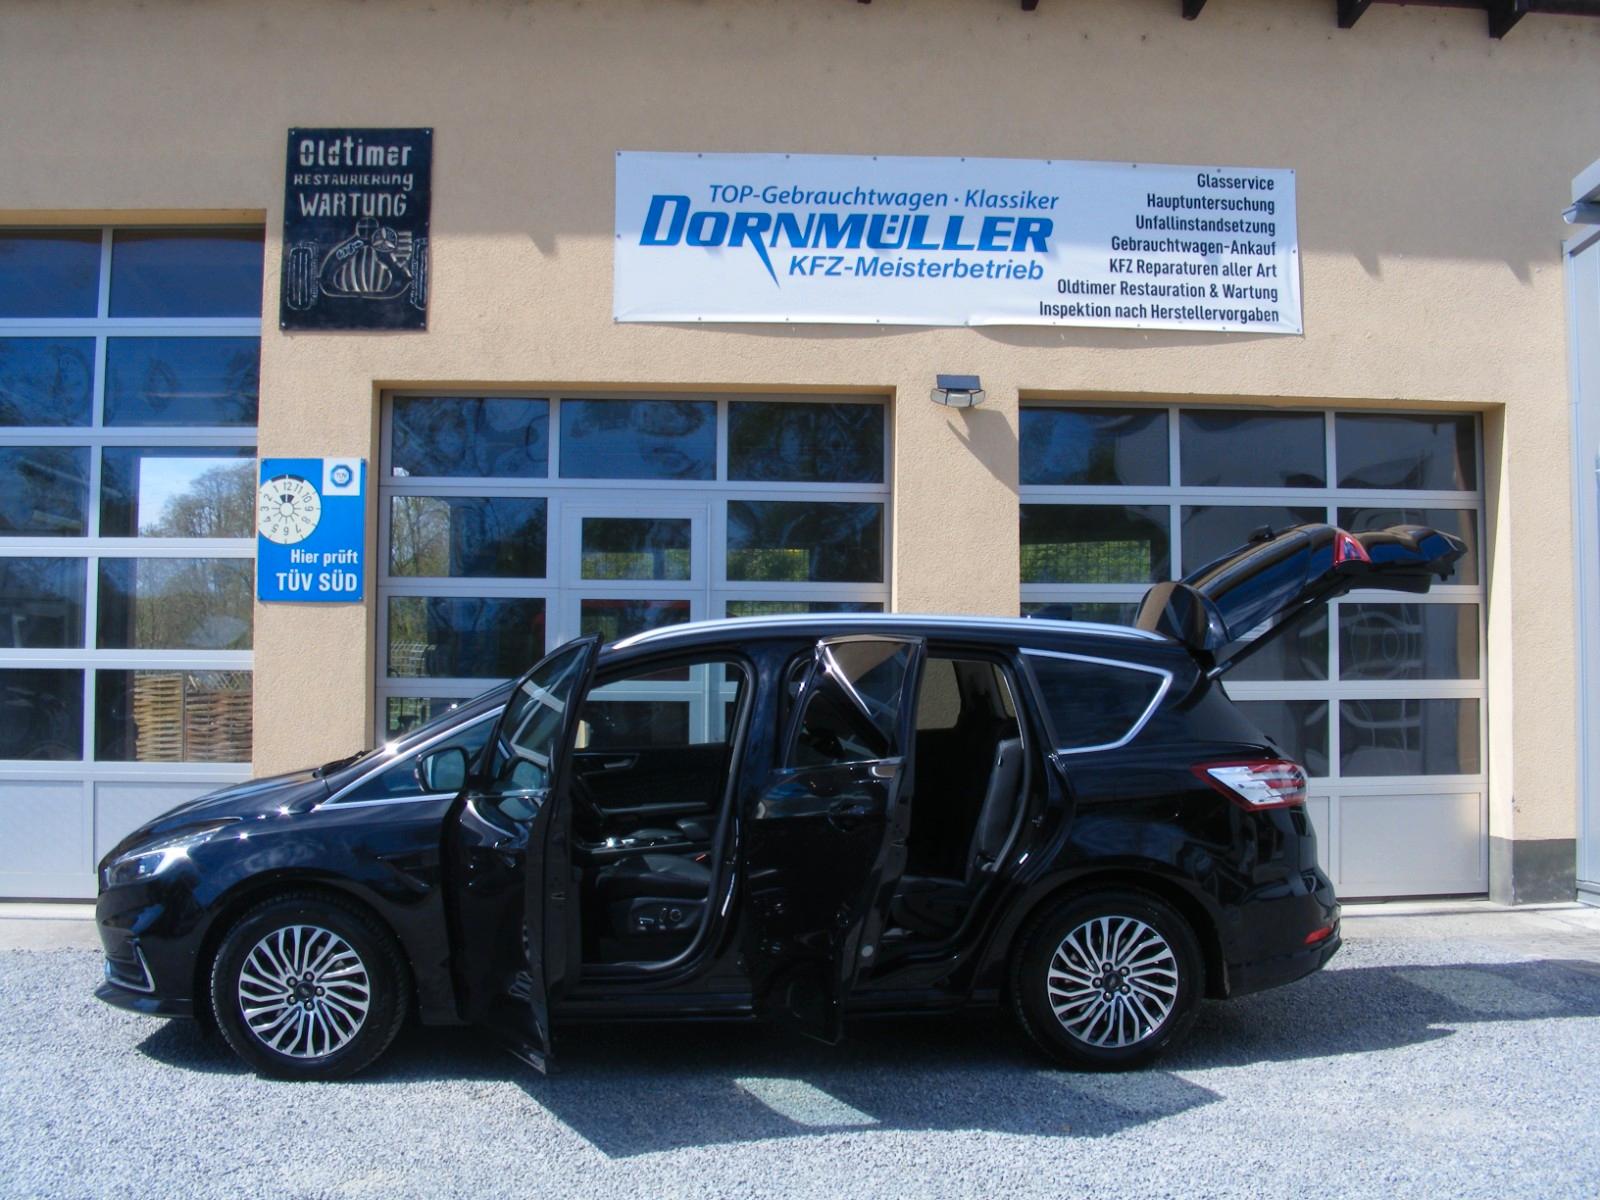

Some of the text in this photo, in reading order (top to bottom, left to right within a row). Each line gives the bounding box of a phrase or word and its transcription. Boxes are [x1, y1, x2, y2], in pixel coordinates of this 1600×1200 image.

[300, 136, 412, 167] Oldtimer
[1197, 173, 1274, 190] Glasservice
[709, 184, 1059, 211] TOP-Gebrauchtwagen Klassiker
[1147, 193, 1275, 215] Hauptuntersuchung
[1135, 214, 1275, 237] Unfallinstandsetzung
[1111, 236, 1276, 256] Gebrauchtwagen-Ankauf
[788, 255, 1044, 280] KFZ-Meisterbetrieb
[1109, 258, 1277, 277] KFZ Reparaturen aller Art
[1057, 279, 1278, 302] Oldtimer Restauration & Wartung
[1039, 301, 1279, 324] Inspektion nach Herstellervorgaben
[290, 549, 359, 567] Hier prüft
[275, 569, 357, 592] TÜV SÜD
